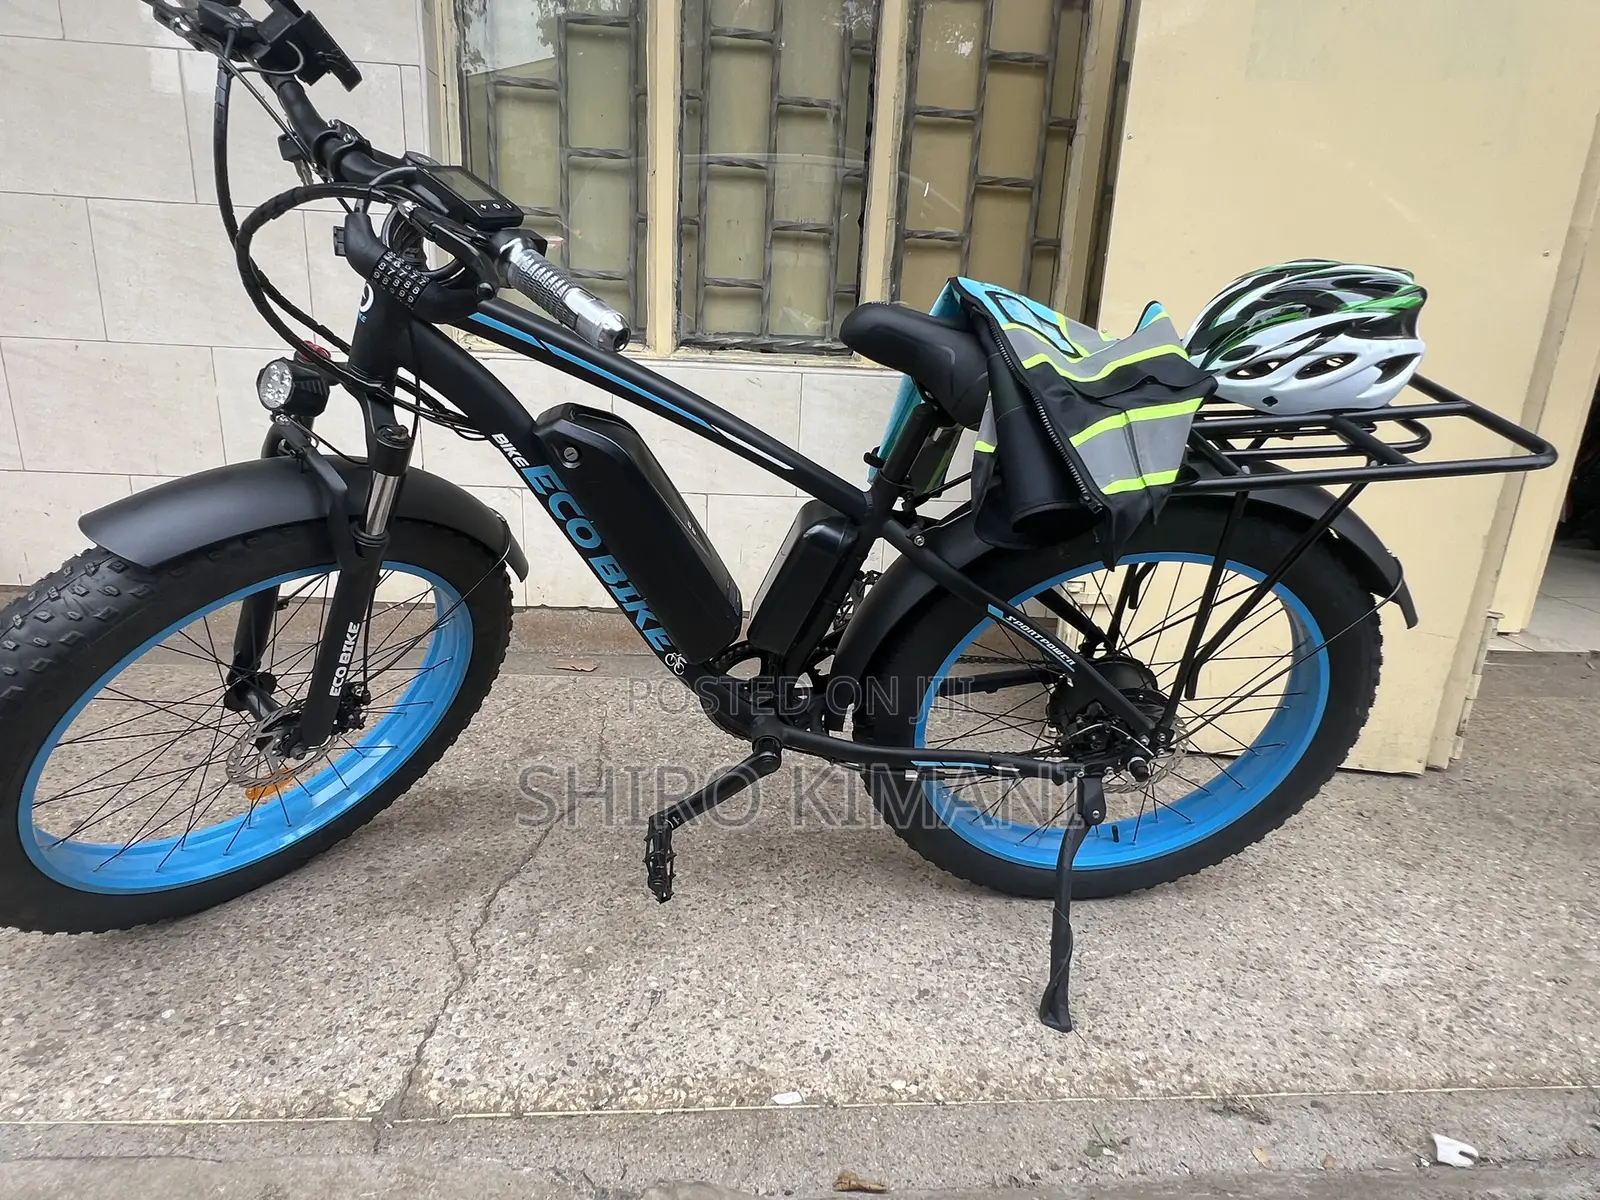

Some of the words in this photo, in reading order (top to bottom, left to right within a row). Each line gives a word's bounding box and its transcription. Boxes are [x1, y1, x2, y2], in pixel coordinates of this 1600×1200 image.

[491, 433, 531, 468] BIKE
[521, 464, 601, 549] ECO
[588, 554, 671, 651] BIKE
[329, 666, 347, 697] ECO
[338, 621, 360, 664] BIKE
